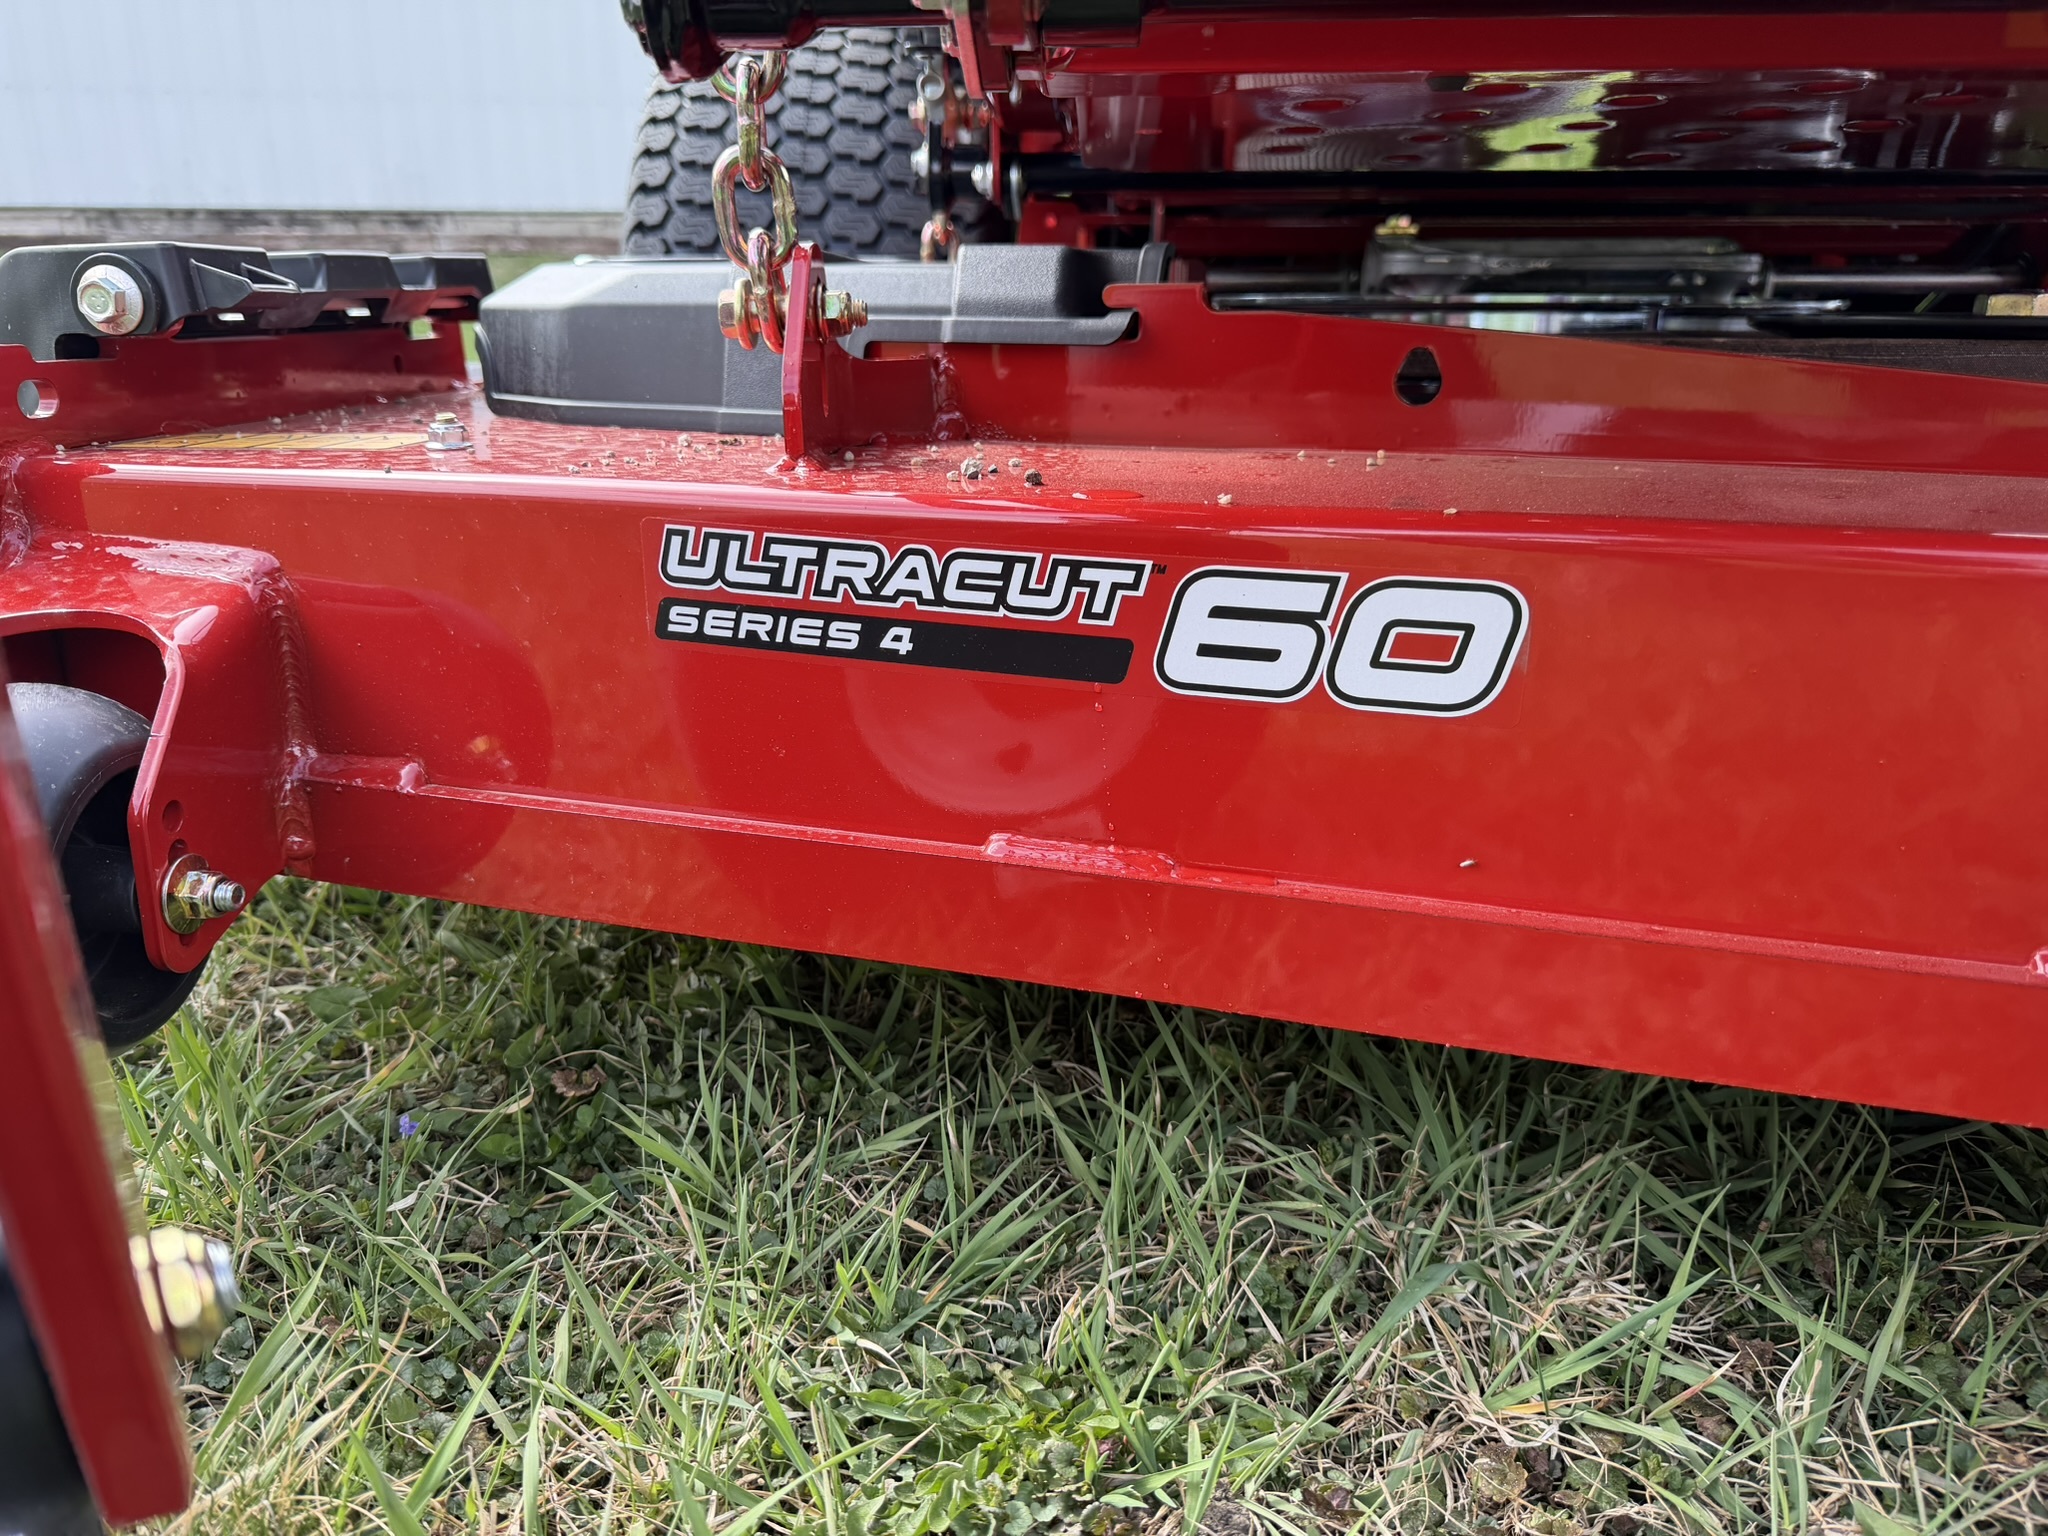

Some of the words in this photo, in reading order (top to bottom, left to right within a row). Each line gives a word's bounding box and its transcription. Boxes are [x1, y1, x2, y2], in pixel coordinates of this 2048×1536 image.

[659, 523, 1153, 627] ULTRACUT
[1153, 564, 1530, 718] 60
[667, 605, 862, 650] SERIES
[879, 626, 914, 655] 4
